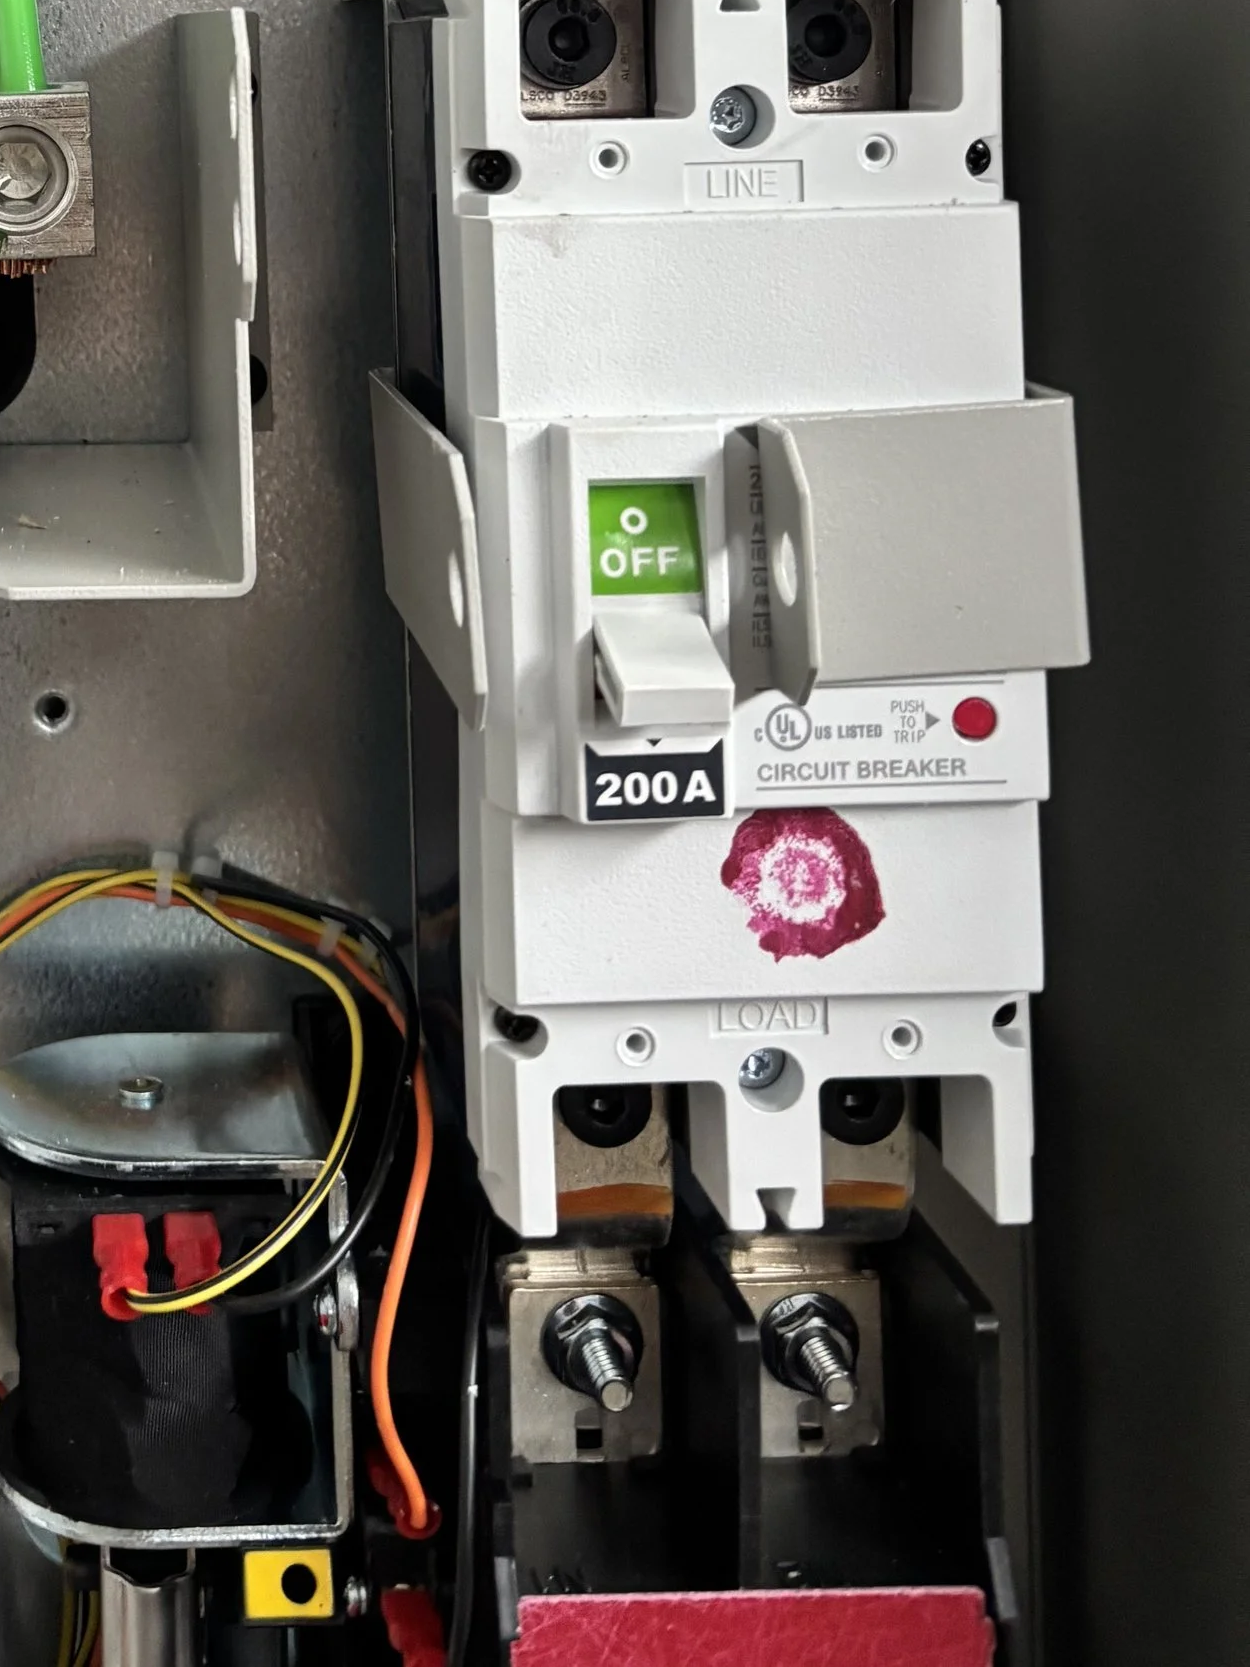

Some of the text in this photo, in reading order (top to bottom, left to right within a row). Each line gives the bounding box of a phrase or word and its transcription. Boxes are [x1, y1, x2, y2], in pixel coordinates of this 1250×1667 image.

[707, 168, 778, 199] LINE
[600, 544, 681, 579] OFF
[890, 699, 925, 713] PUSH
[837, 723, 883, 739] LISTED
[900, 716, 916, 729] TO
[894, 729, 926, 743] TRIP
[757, 757, 966, 782] CIRCUIT BREAKER
[716, 1000, 821, 1032] LOAD
